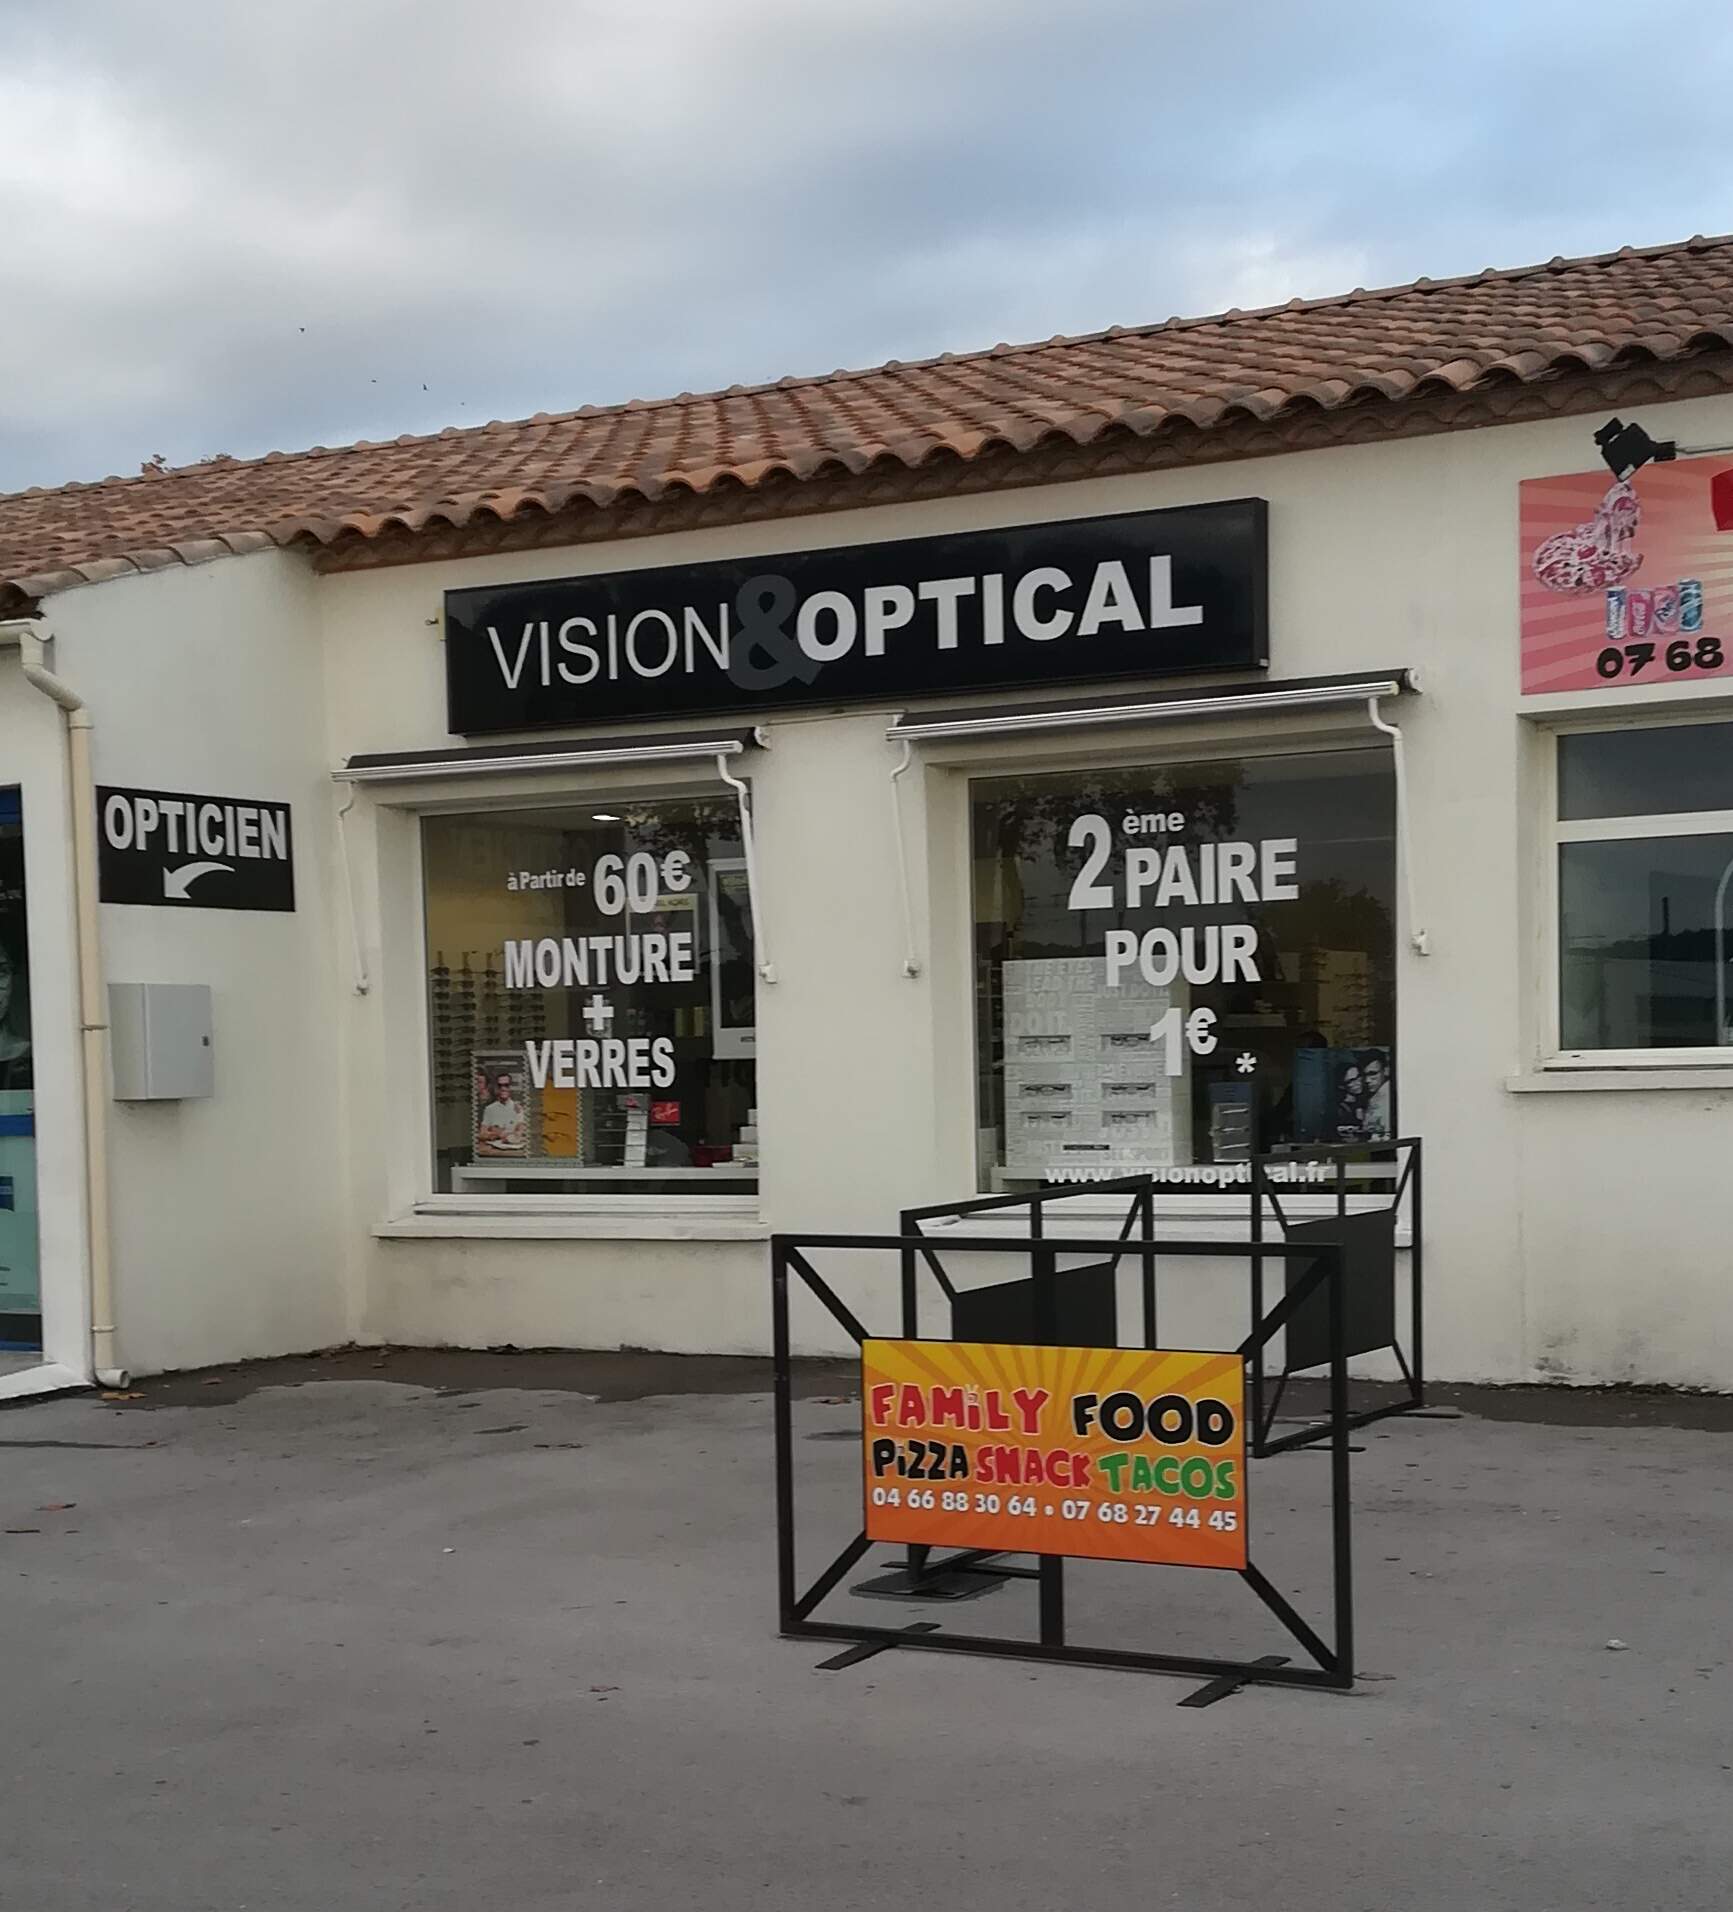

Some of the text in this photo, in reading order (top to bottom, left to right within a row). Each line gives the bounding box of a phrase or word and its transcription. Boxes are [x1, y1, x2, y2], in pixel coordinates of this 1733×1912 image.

[1596, 637, 1724, 679] 07 68
[104, 794, 289, 861] OPTICIEN
[507, 871, 518, 890] à
[519, 869, 564, 890] Partir
[565, 868, 586, 887] de
[1125, 838, 1299, 908] PAIRE
[504, 932, 694, 989] MONTURE
[1105, 924, 1261, 987] POUR
[525, 1037, 675, 1089] VERRES
[1045, 1160, 1326, 1188] wwwvsionoptial.fr
[1072, 1389, 1236, 1447] FOOD
[975, 1444, 1091, 1489] SNACK
[1097, 1451, 1236, 1500] TACOS
[873, 1487, 900, 1507] 04
[907, 1489, 935, 1510] 66
[941, 1491, 969, 1512] 88
[974, 1494, 1000, 1514] 30
[1007, 1496, 1037, 1517] 64
[1062, 1500, 1090, 1520] 07
[1098, 1502, 1129, 1523] 68
[1134, 1504, 1162, 1526] 27
[1168, 1507, 1201, 1529] 44
[1207, 1510, 1238, 1532] 45
